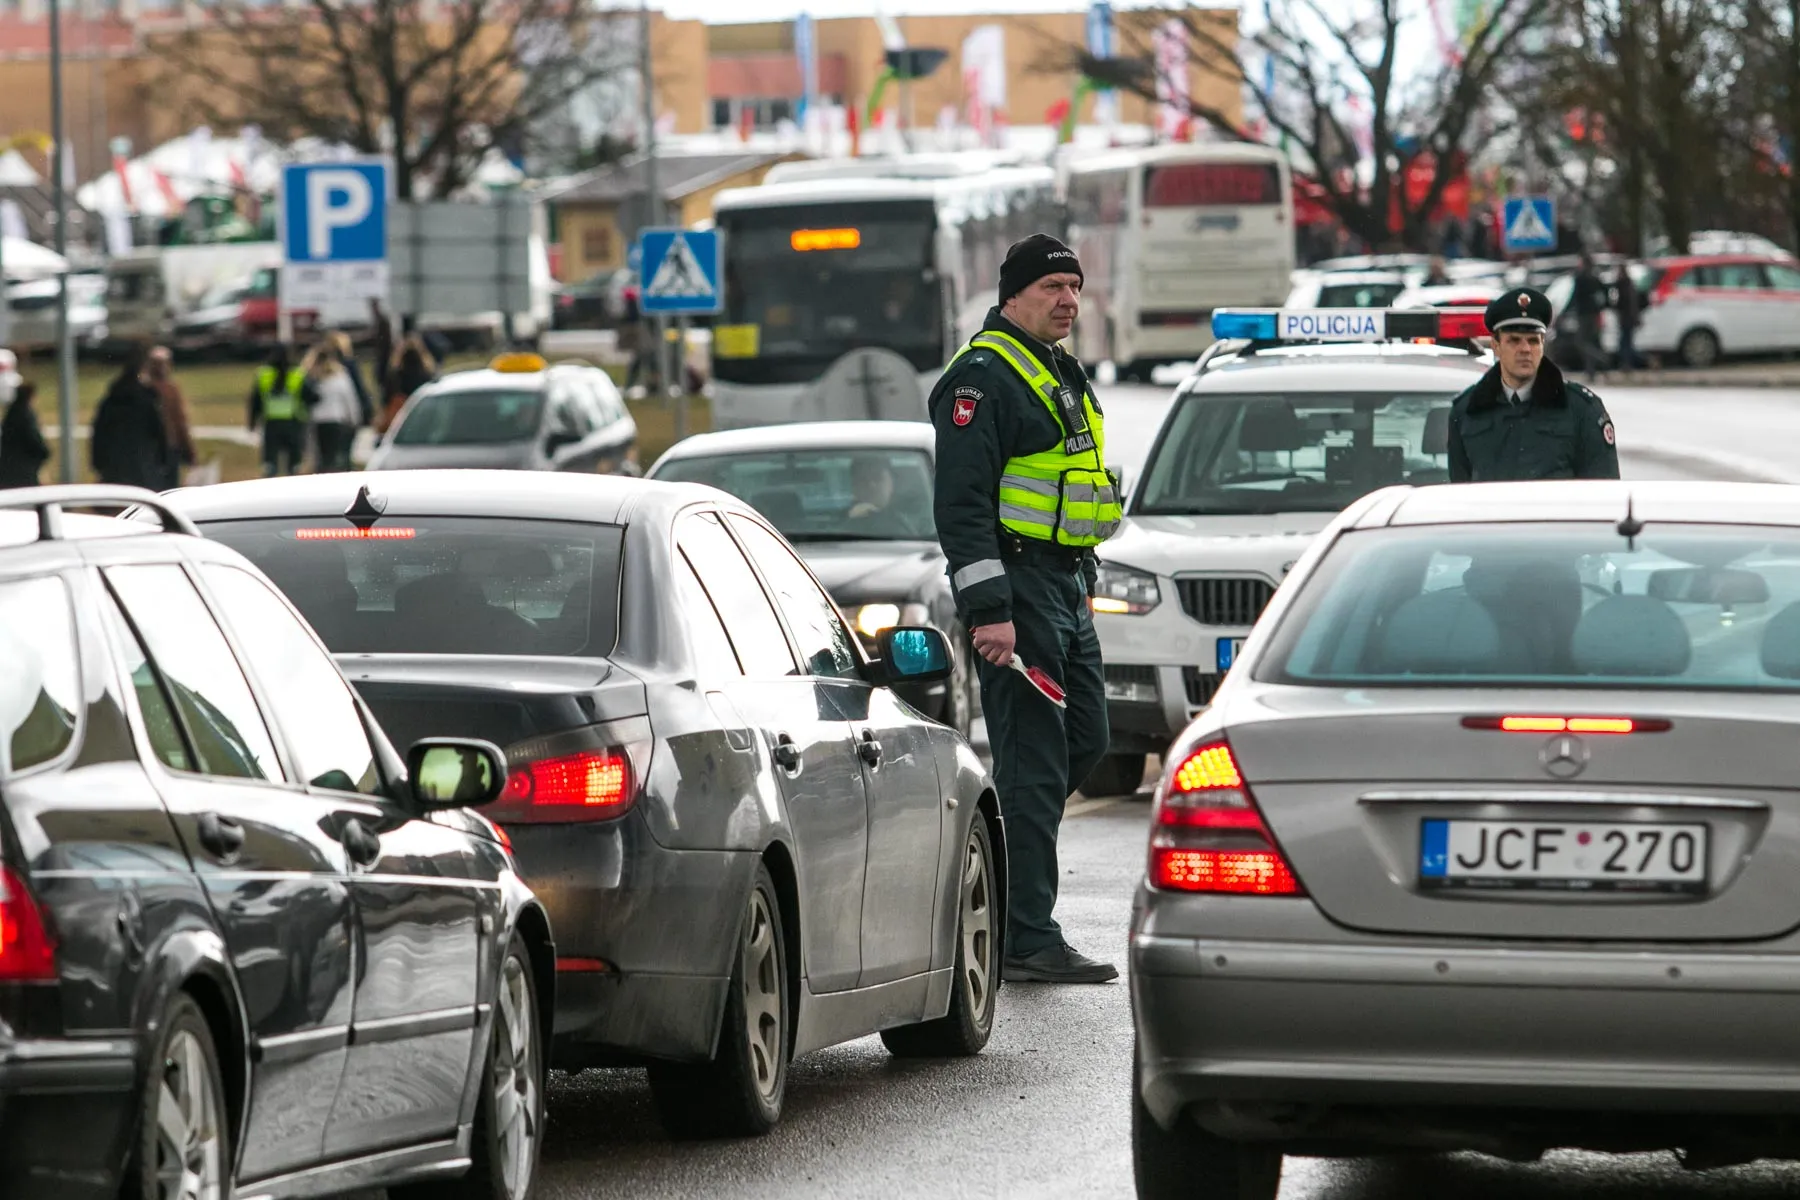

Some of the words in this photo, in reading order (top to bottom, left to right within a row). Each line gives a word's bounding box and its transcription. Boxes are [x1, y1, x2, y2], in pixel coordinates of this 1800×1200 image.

[306, 169, 374, 260] P
[1287, 315, 1376, 334] POLICIJA
[956, 388, 981, 398] KAUNAS
[1456, 828, 1566, 870] JCF
[1602, 830, 1696, 873] 270
